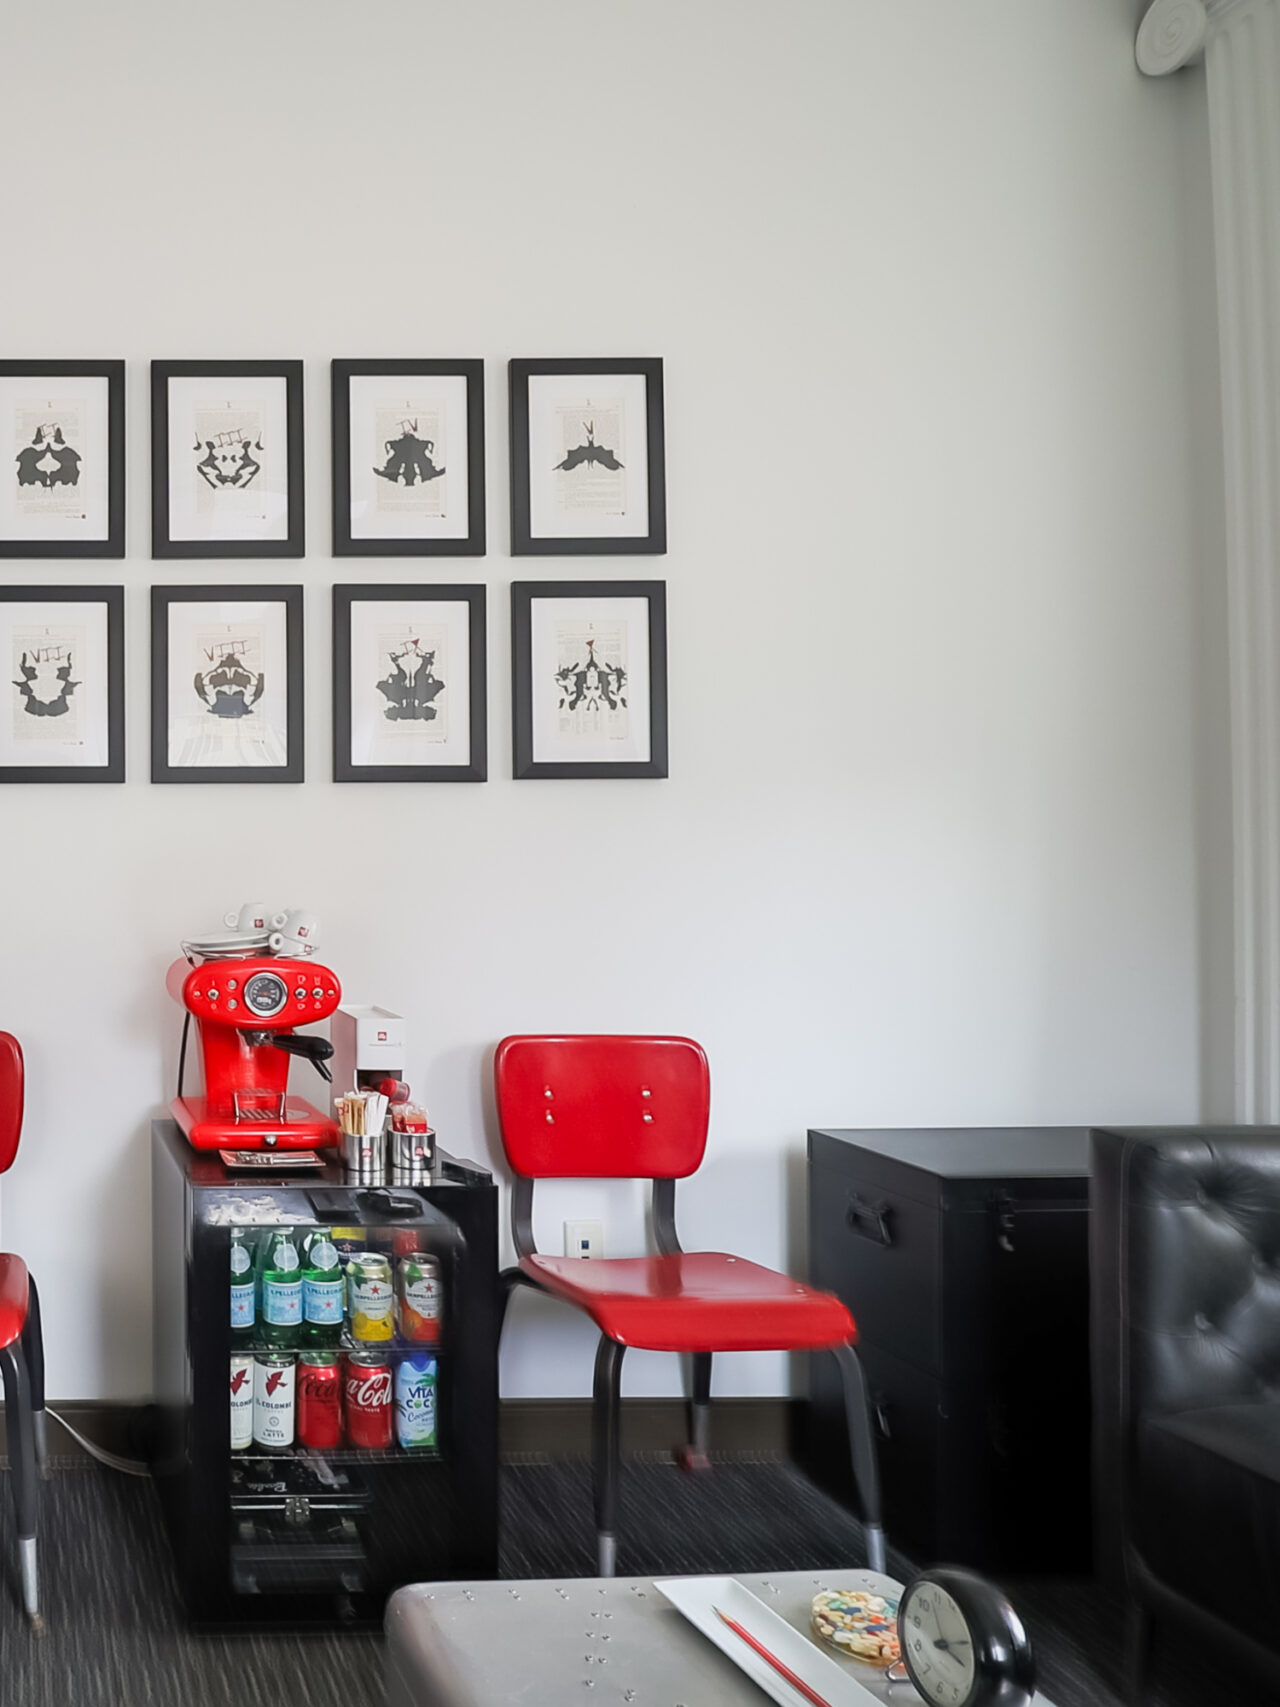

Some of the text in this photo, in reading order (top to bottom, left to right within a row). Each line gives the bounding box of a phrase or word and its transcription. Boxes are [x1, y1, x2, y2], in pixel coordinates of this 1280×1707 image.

[582, 419, 594, 436] V
[408, 1386, 433, 1399] VITA
[918, 1597, 930, 1613] 10
[914, 1615, 921, 1629] 9
[914, 1639, 922, 1652] 8
[936, 1681, 944, 1694] 6
